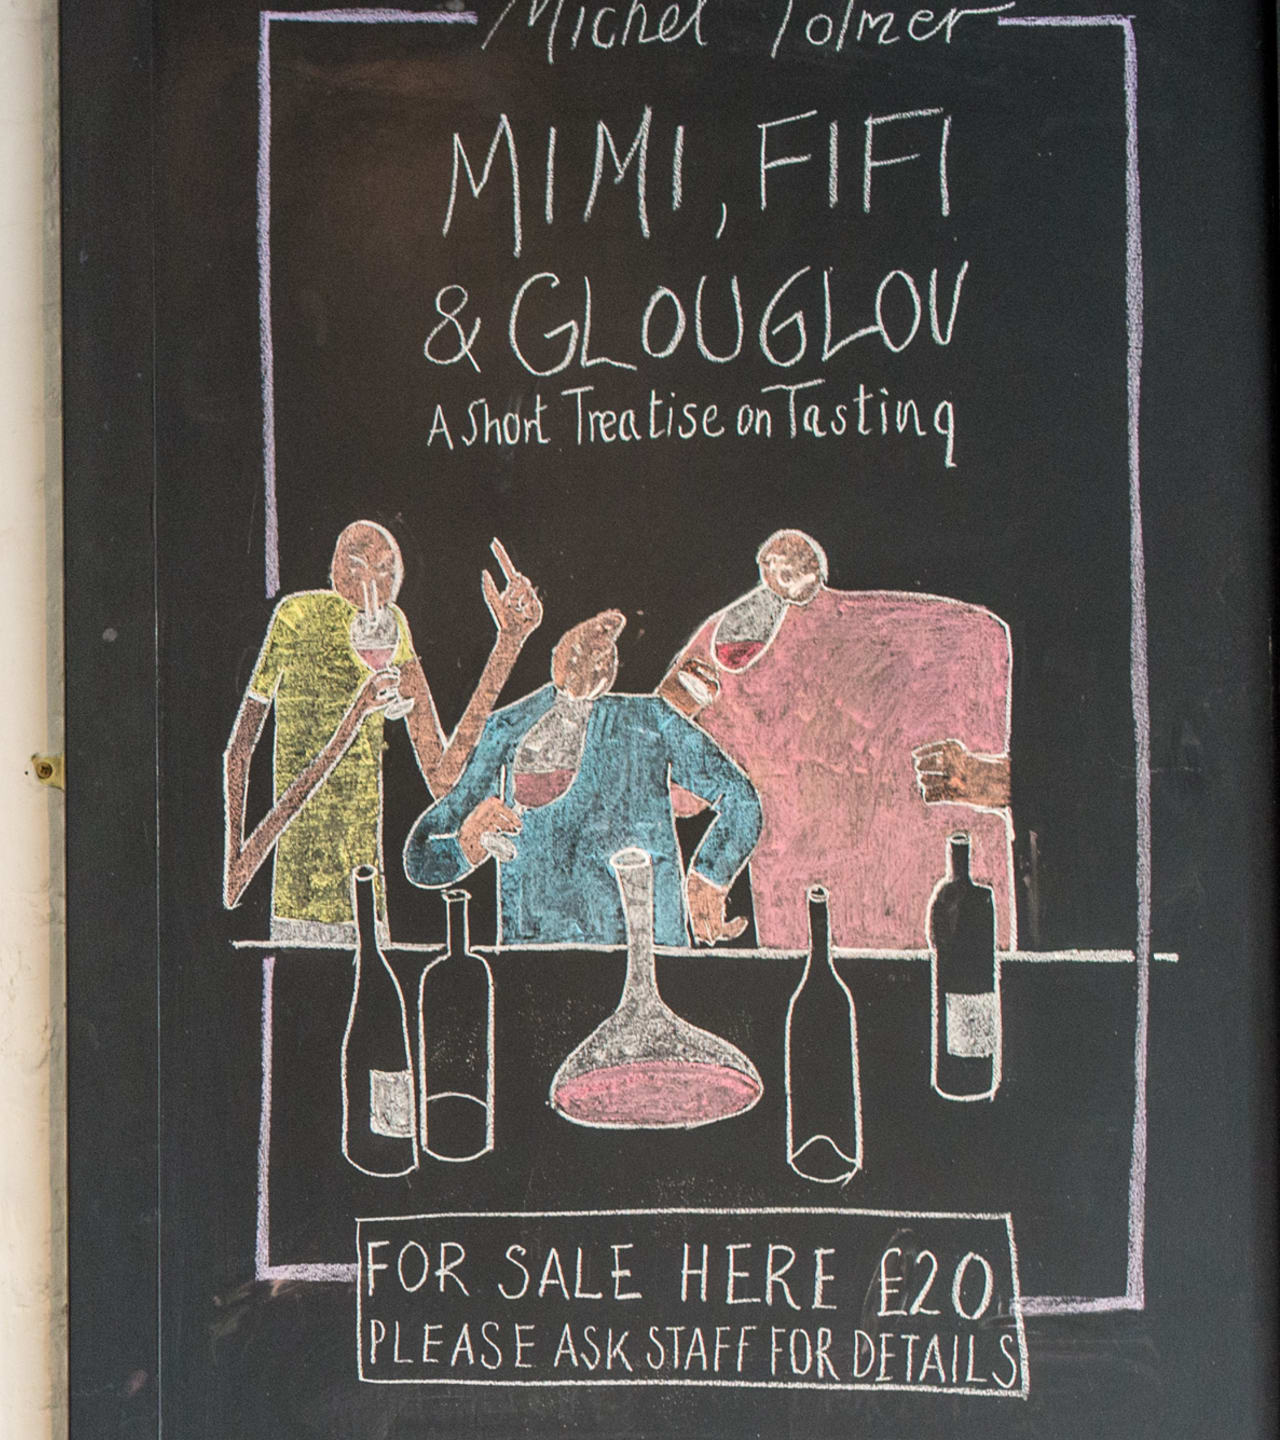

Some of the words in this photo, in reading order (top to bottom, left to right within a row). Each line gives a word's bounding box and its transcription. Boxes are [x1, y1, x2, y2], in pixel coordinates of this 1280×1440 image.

[442, 106, 730, 258] MIMI,
[758, 108, 952, 218] FIFI
[423, 283, 482, 373] &
[427, 404, 455, 448] A
[462, 391, 551, 445] Short
[562, 384, 725, 442] Treatise
[737, 405, 772, 440] on
[761, 378, 958, 469] Tasting
[366, 1240, 470, 1298] FOR
[498, 1242, 643, 1300] SALE
[680, 1240, 839, 1311] HERE
[877, 1247, 994, 1320] £20
[368, 1318, 536, 1369] PLEASE
[554, 1323, 633, 1374] ASK
[646, 1324, 756, 1374] STAFF
[771, 1325, 839, 1380] FOR
[852, 1327, 1023, 1389] DETAILS
